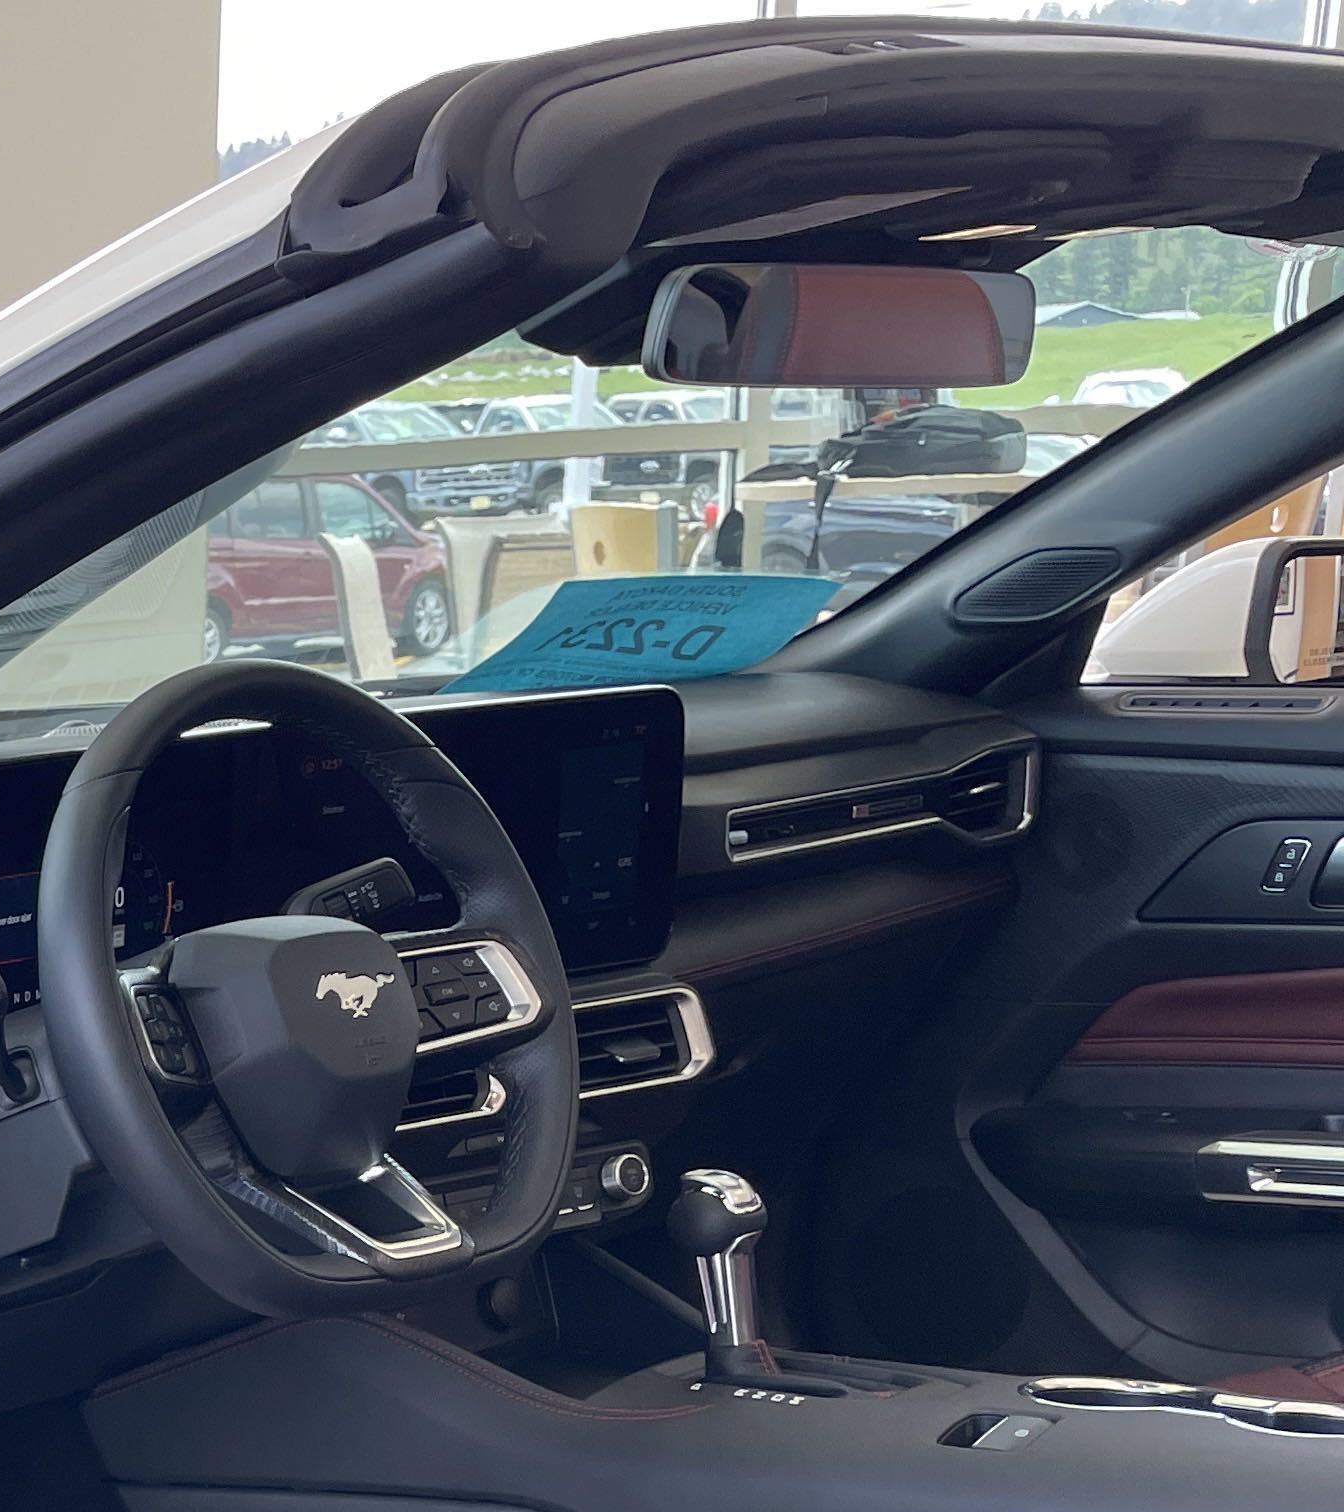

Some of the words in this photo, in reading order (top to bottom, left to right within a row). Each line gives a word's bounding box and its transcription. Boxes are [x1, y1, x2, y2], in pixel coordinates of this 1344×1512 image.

[114, 886, 125, 908] 0
[13, 992, 21, 1004] N
[24, 990, 31, 1002] D
